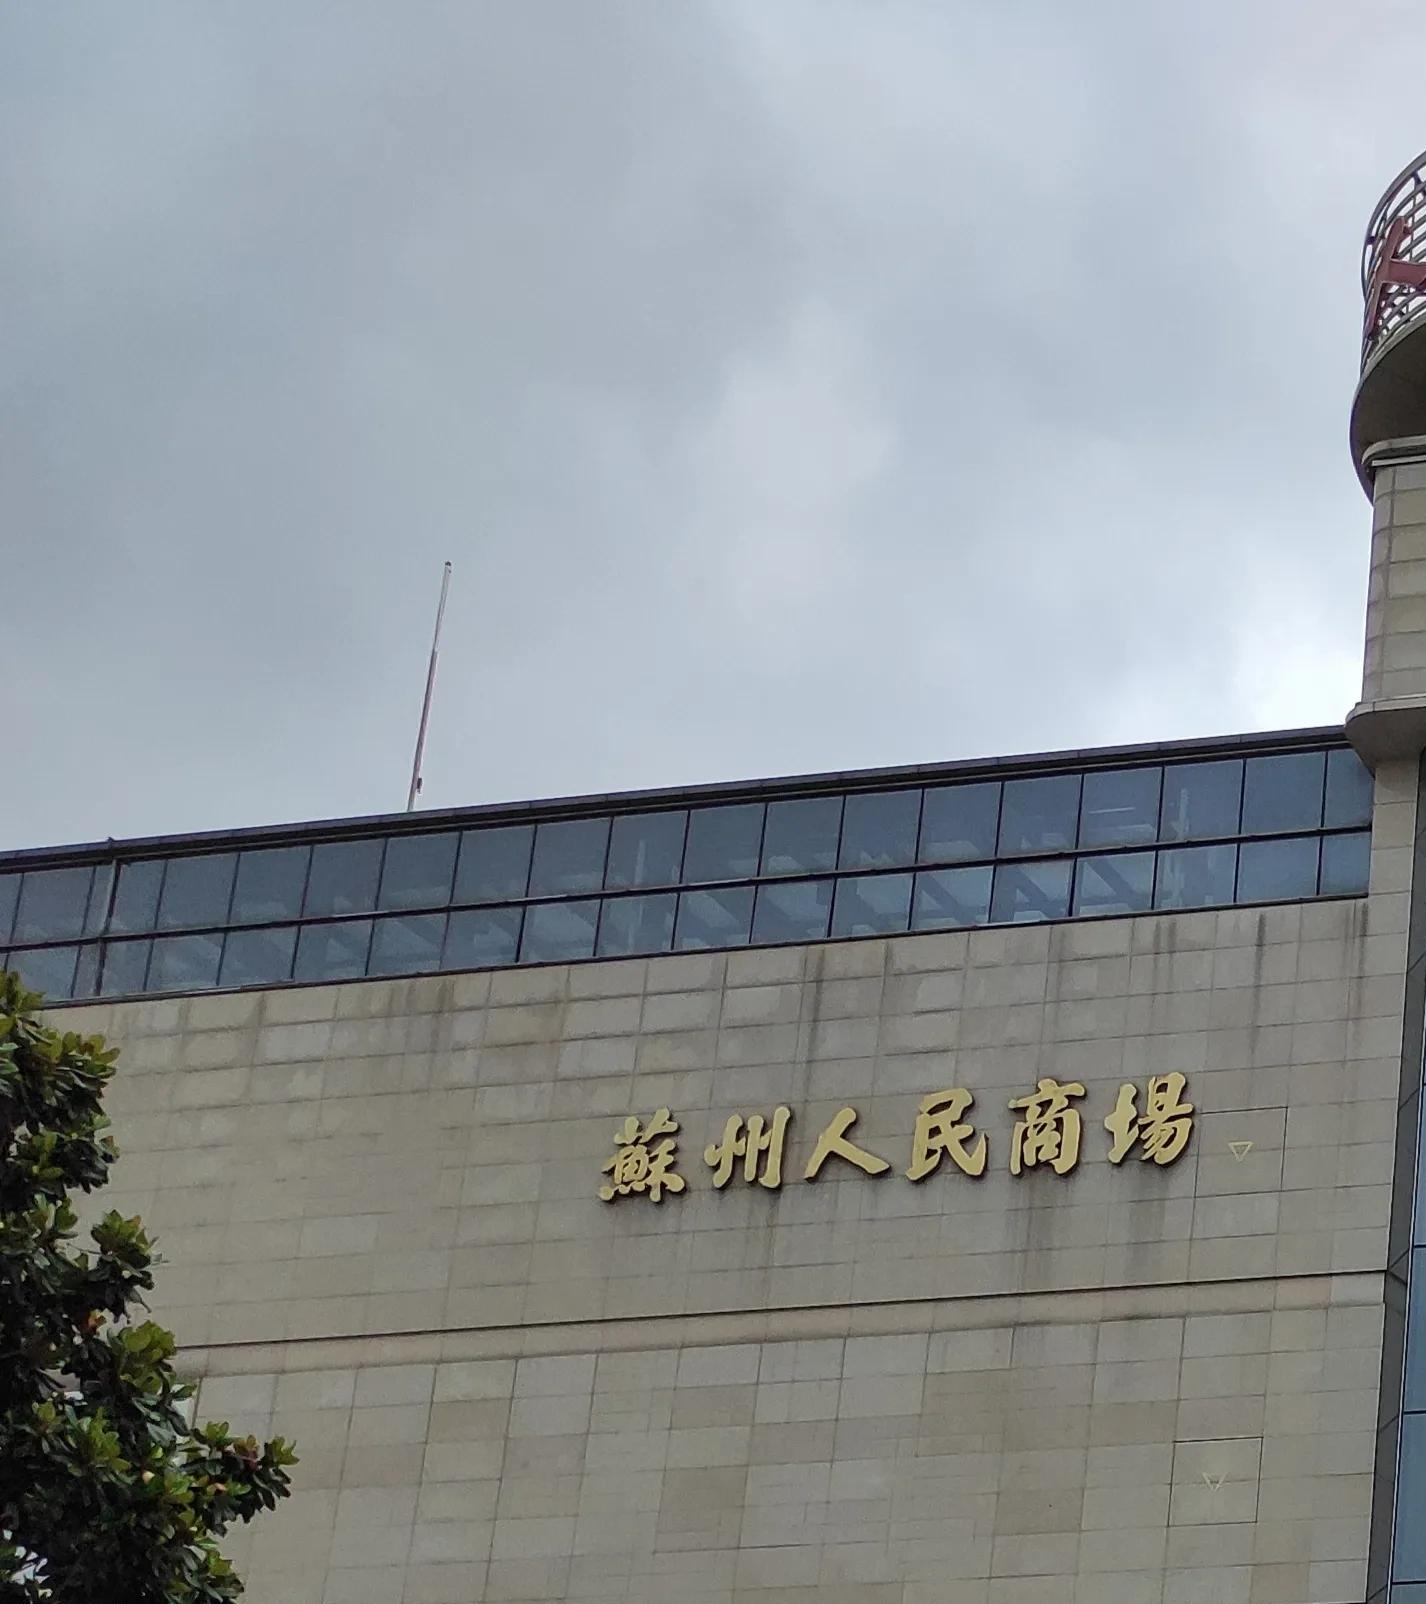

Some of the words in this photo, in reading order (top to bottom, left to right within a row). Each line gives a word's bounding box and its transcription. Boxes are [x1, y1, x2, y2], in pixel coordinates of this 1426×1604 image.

[600, 1071, 1195, 1202] 蘇州人民商場
